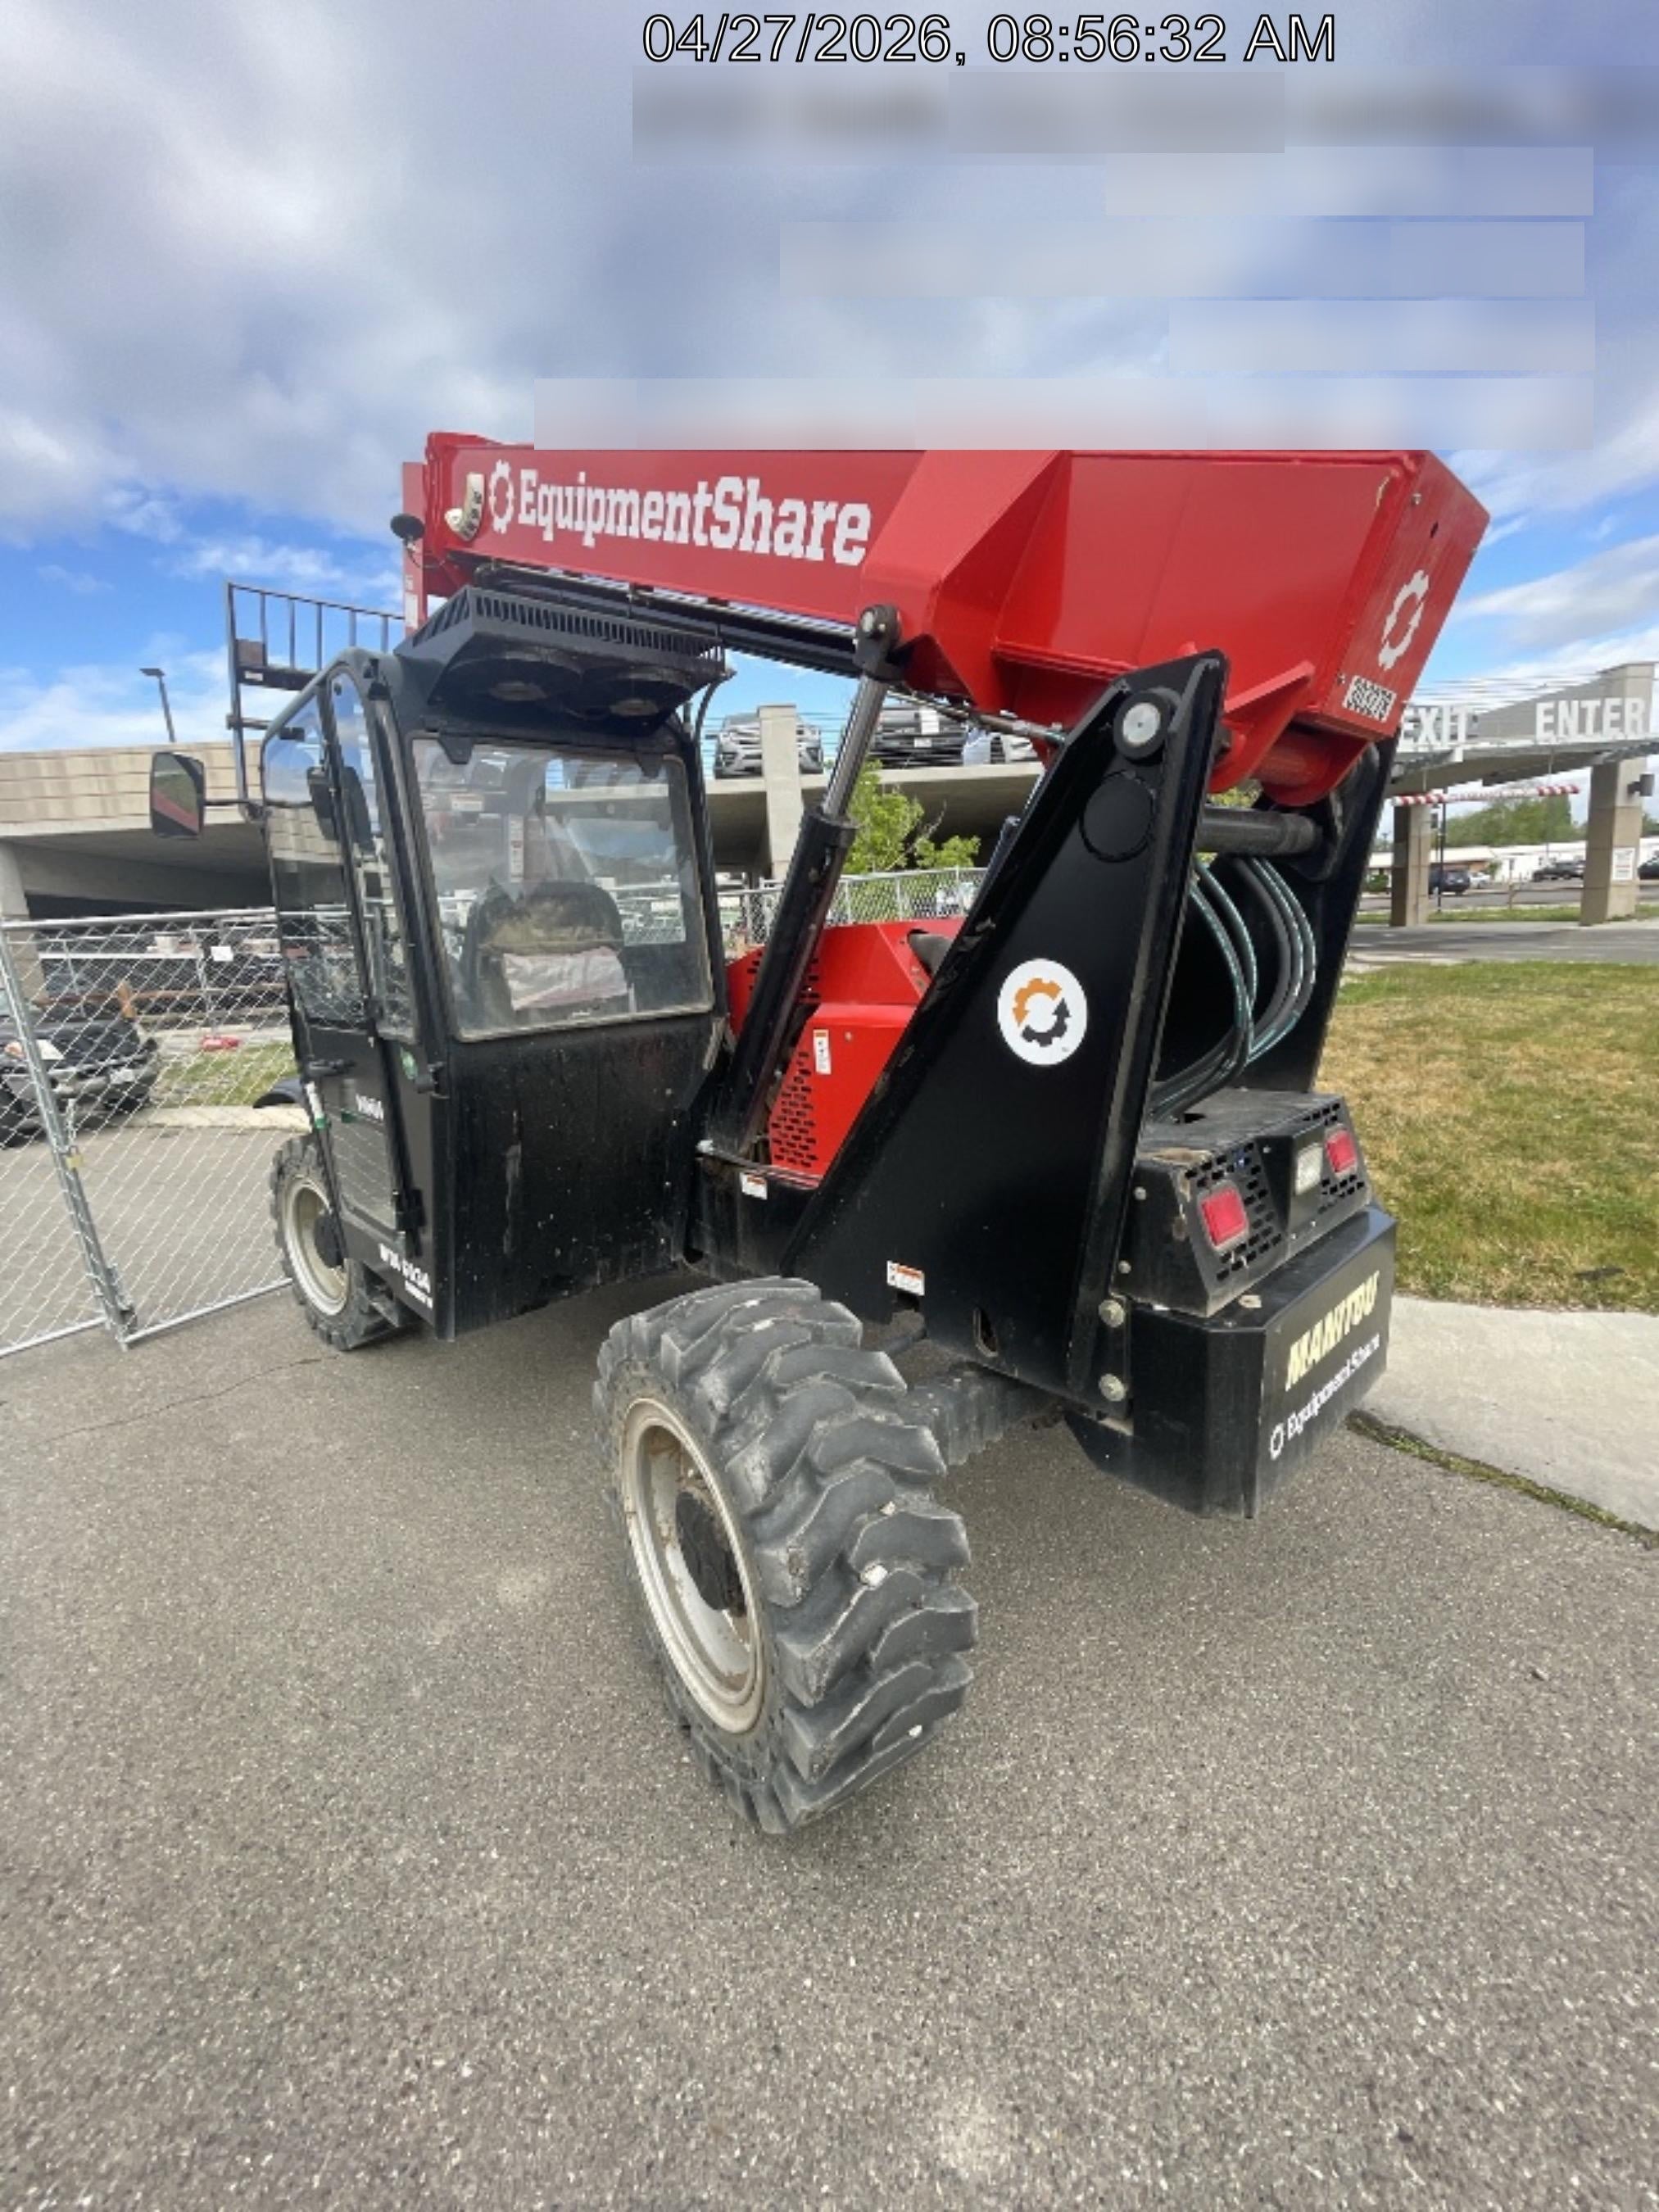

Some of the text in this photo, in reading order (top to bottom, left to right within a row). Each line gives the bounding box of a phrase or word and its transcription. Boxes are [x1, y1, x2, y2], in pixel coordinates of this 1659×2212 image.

[518, 471, 873, 566] EquipmentShare
[1396, 705, 1467, 750] EXIT
[1535, 696, 1647, 745] ENTER
[1285, 1270, 1380, 1392] MANITOU
